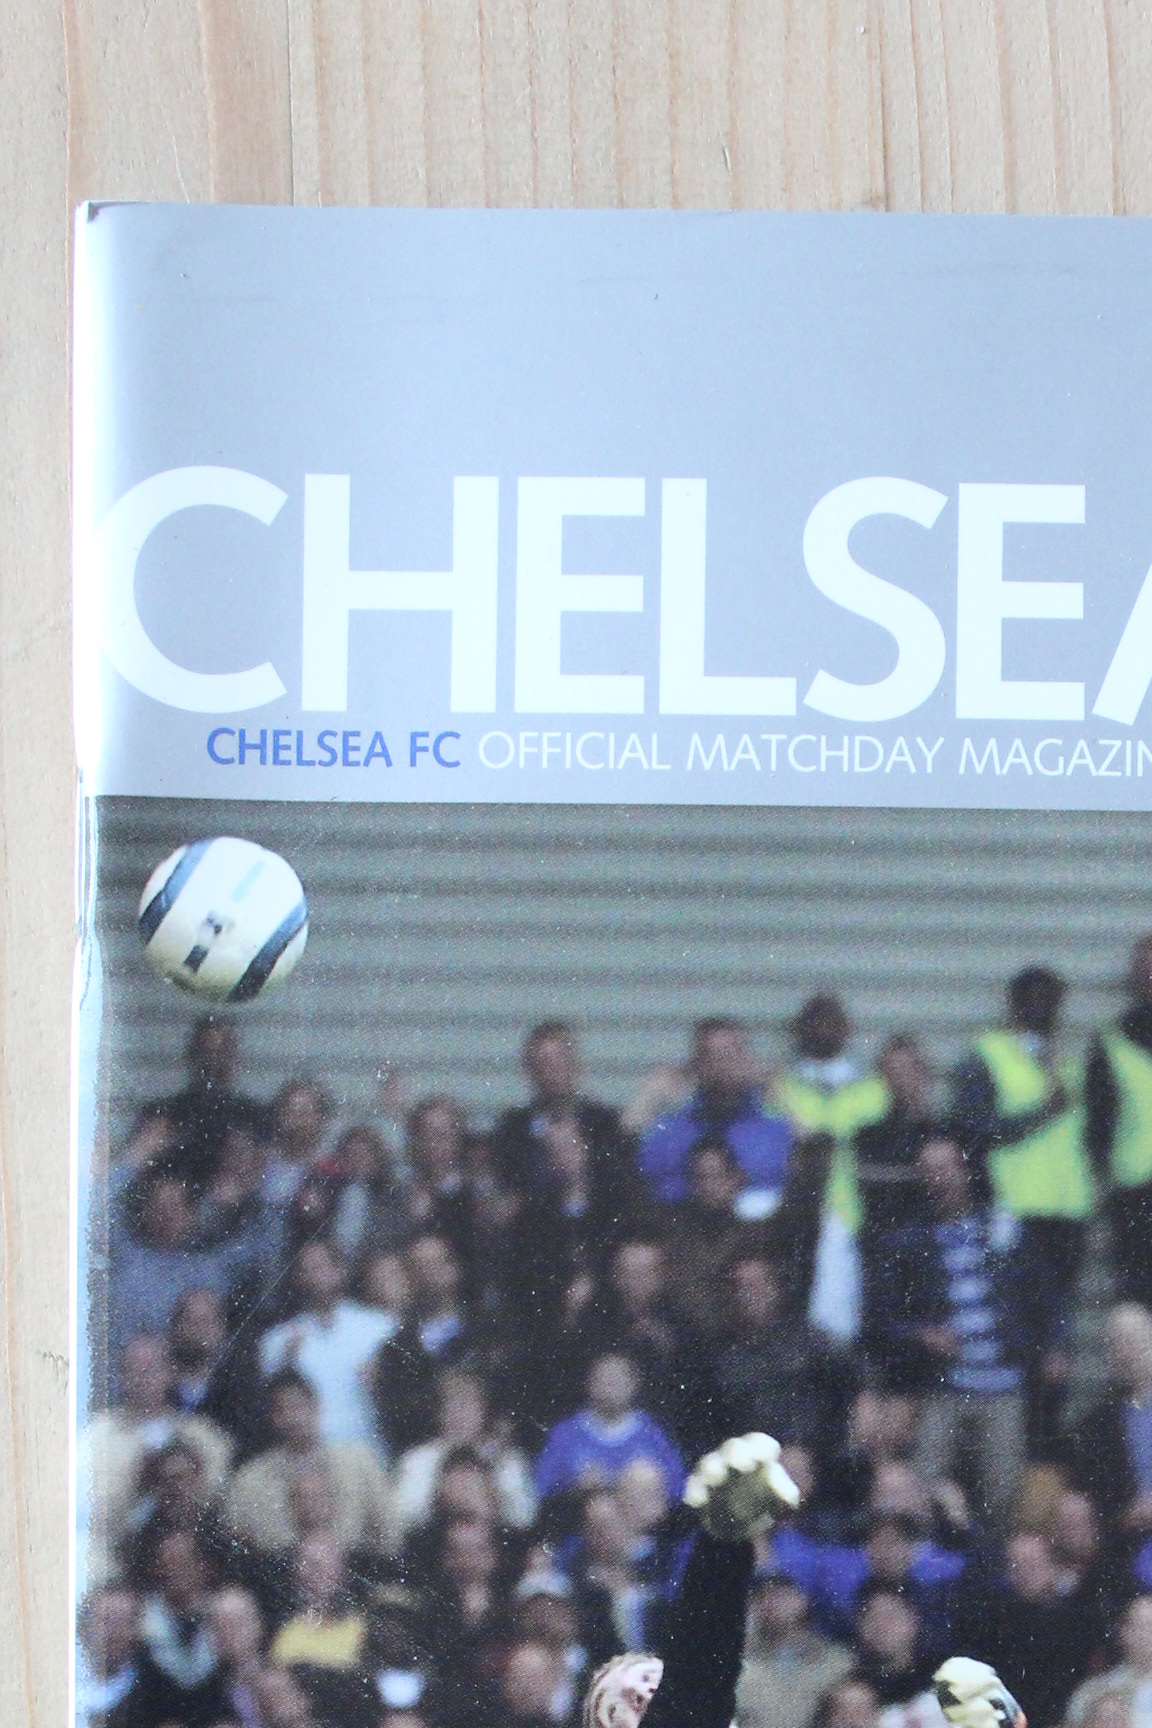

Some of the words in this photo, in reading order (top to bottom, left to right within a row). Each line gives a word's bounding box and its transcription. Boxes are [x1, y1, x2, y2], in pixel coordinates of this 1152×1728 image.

[206, 726, 393, 768] CHELSEA
[409, 730, 461, 768] FC
[478, 730, 672, 770] OFFICIAL
[686, 732, 946, 774] MATCHDAY
